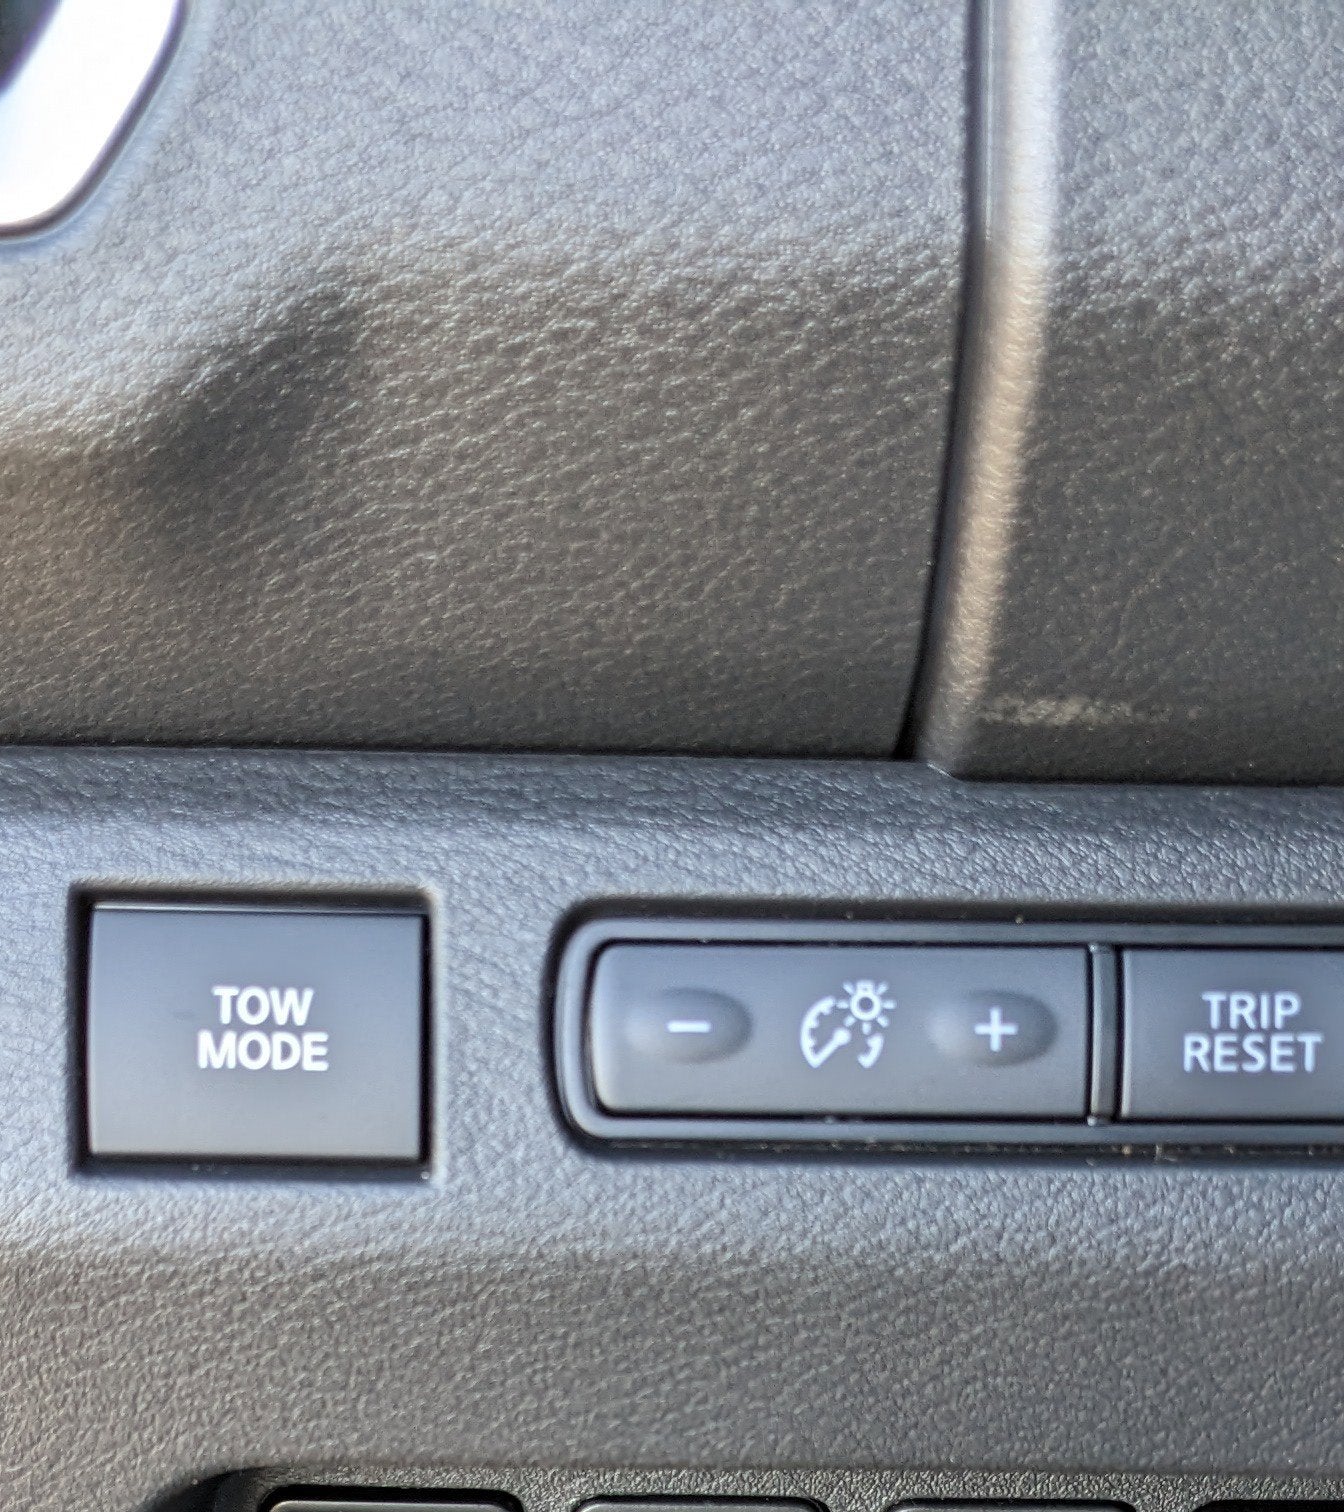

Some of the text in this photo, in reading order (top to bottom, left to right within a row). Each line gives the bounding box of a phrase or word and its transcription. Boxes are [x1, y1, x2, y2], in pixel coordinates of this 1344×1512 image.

[211, 985, 315, 1027] TOW
[1201, 991, 1302, 1030] TRIP
[196, 1029, 330, 1071] MODE
[1182, 1033, 1325, 1073] RESET
